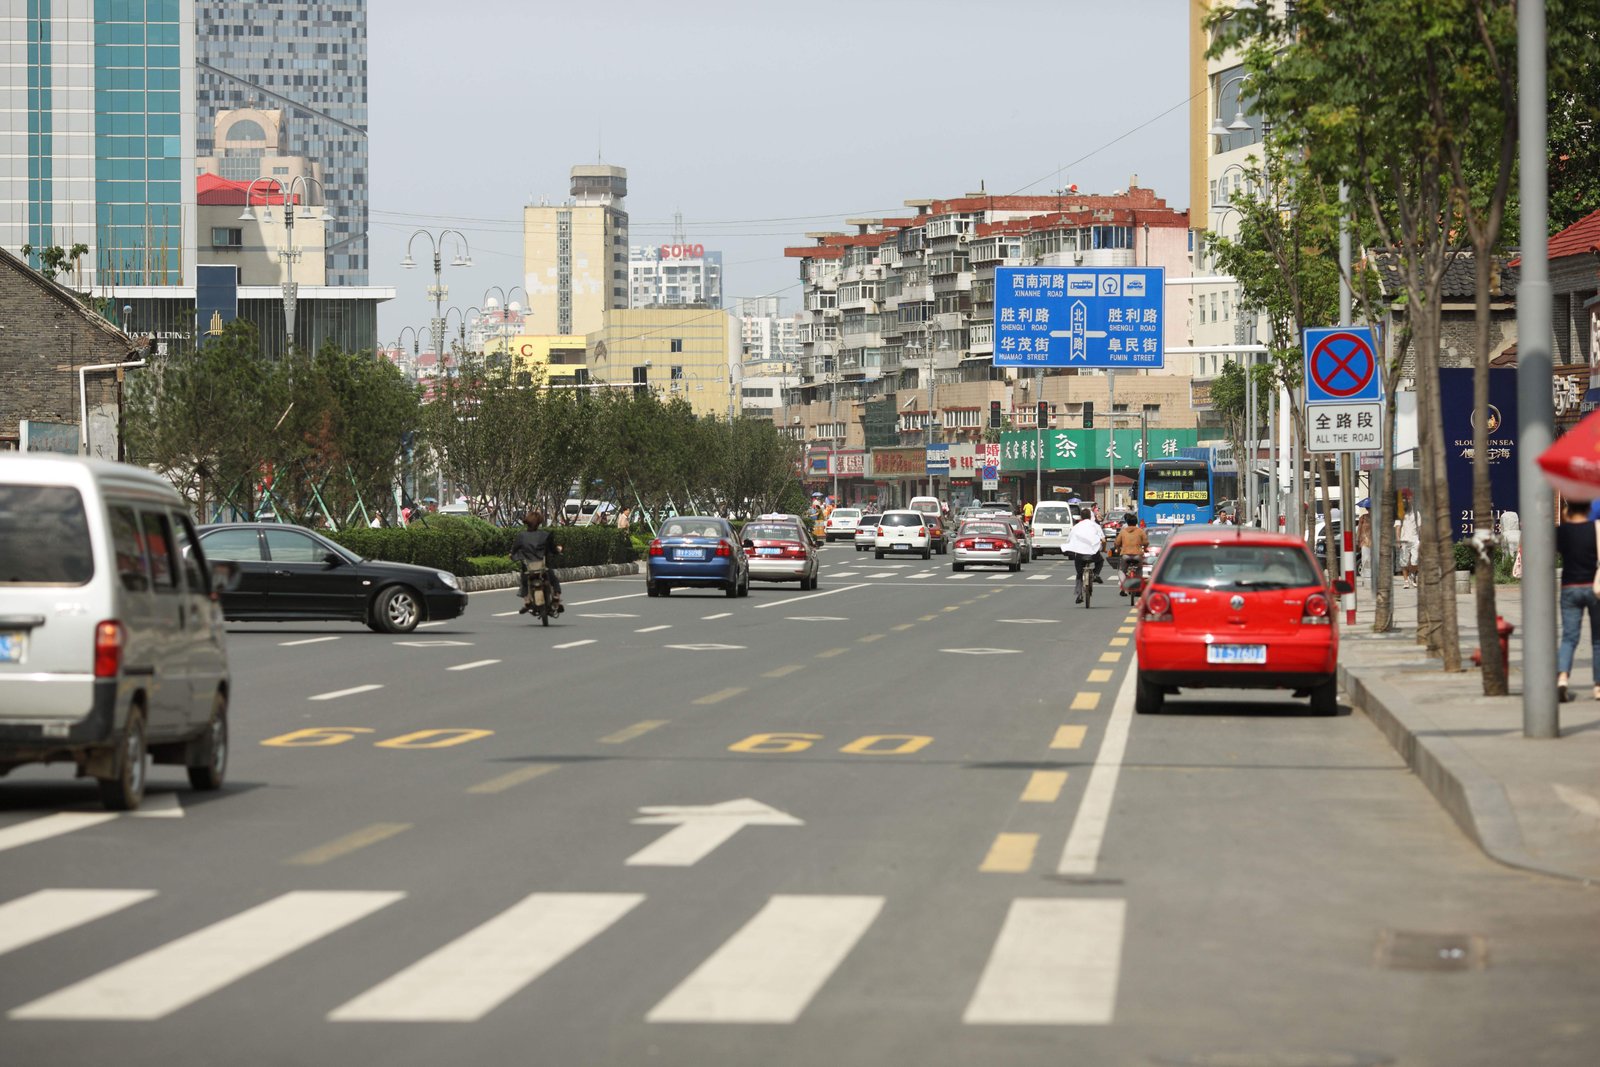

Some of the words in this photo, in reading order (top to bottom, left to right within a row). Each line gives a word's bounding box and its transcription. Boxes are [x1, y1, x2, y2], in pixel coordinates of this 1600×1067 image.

[661, 243, 704, 258] SOHO
[1012, 274, 1065, 289] 西南河路
[1047, 290, 1064, 298] ROAD
[1001, 307, 1050, 323] 胜利路
[1108, 308, 1157, 323] 胜利路
[1073, 308, 1084, 350] 北马路
[1109, 324, 1134, 332] SHENGLI
[1140, 324, 1157, 332] ROAD
[1001, 337, 1049, 352] 华茂街
[1108, 337, 1157, 352] 阜民街
[1316, 412, 1373, 430] 全路段
[1055, 433, 1078, 457] 茶
[1316, 434, 1330, 443] ALL
[1333, 433, 1348, 443] THE
[1352, 433, 1374, 442] ROAD
